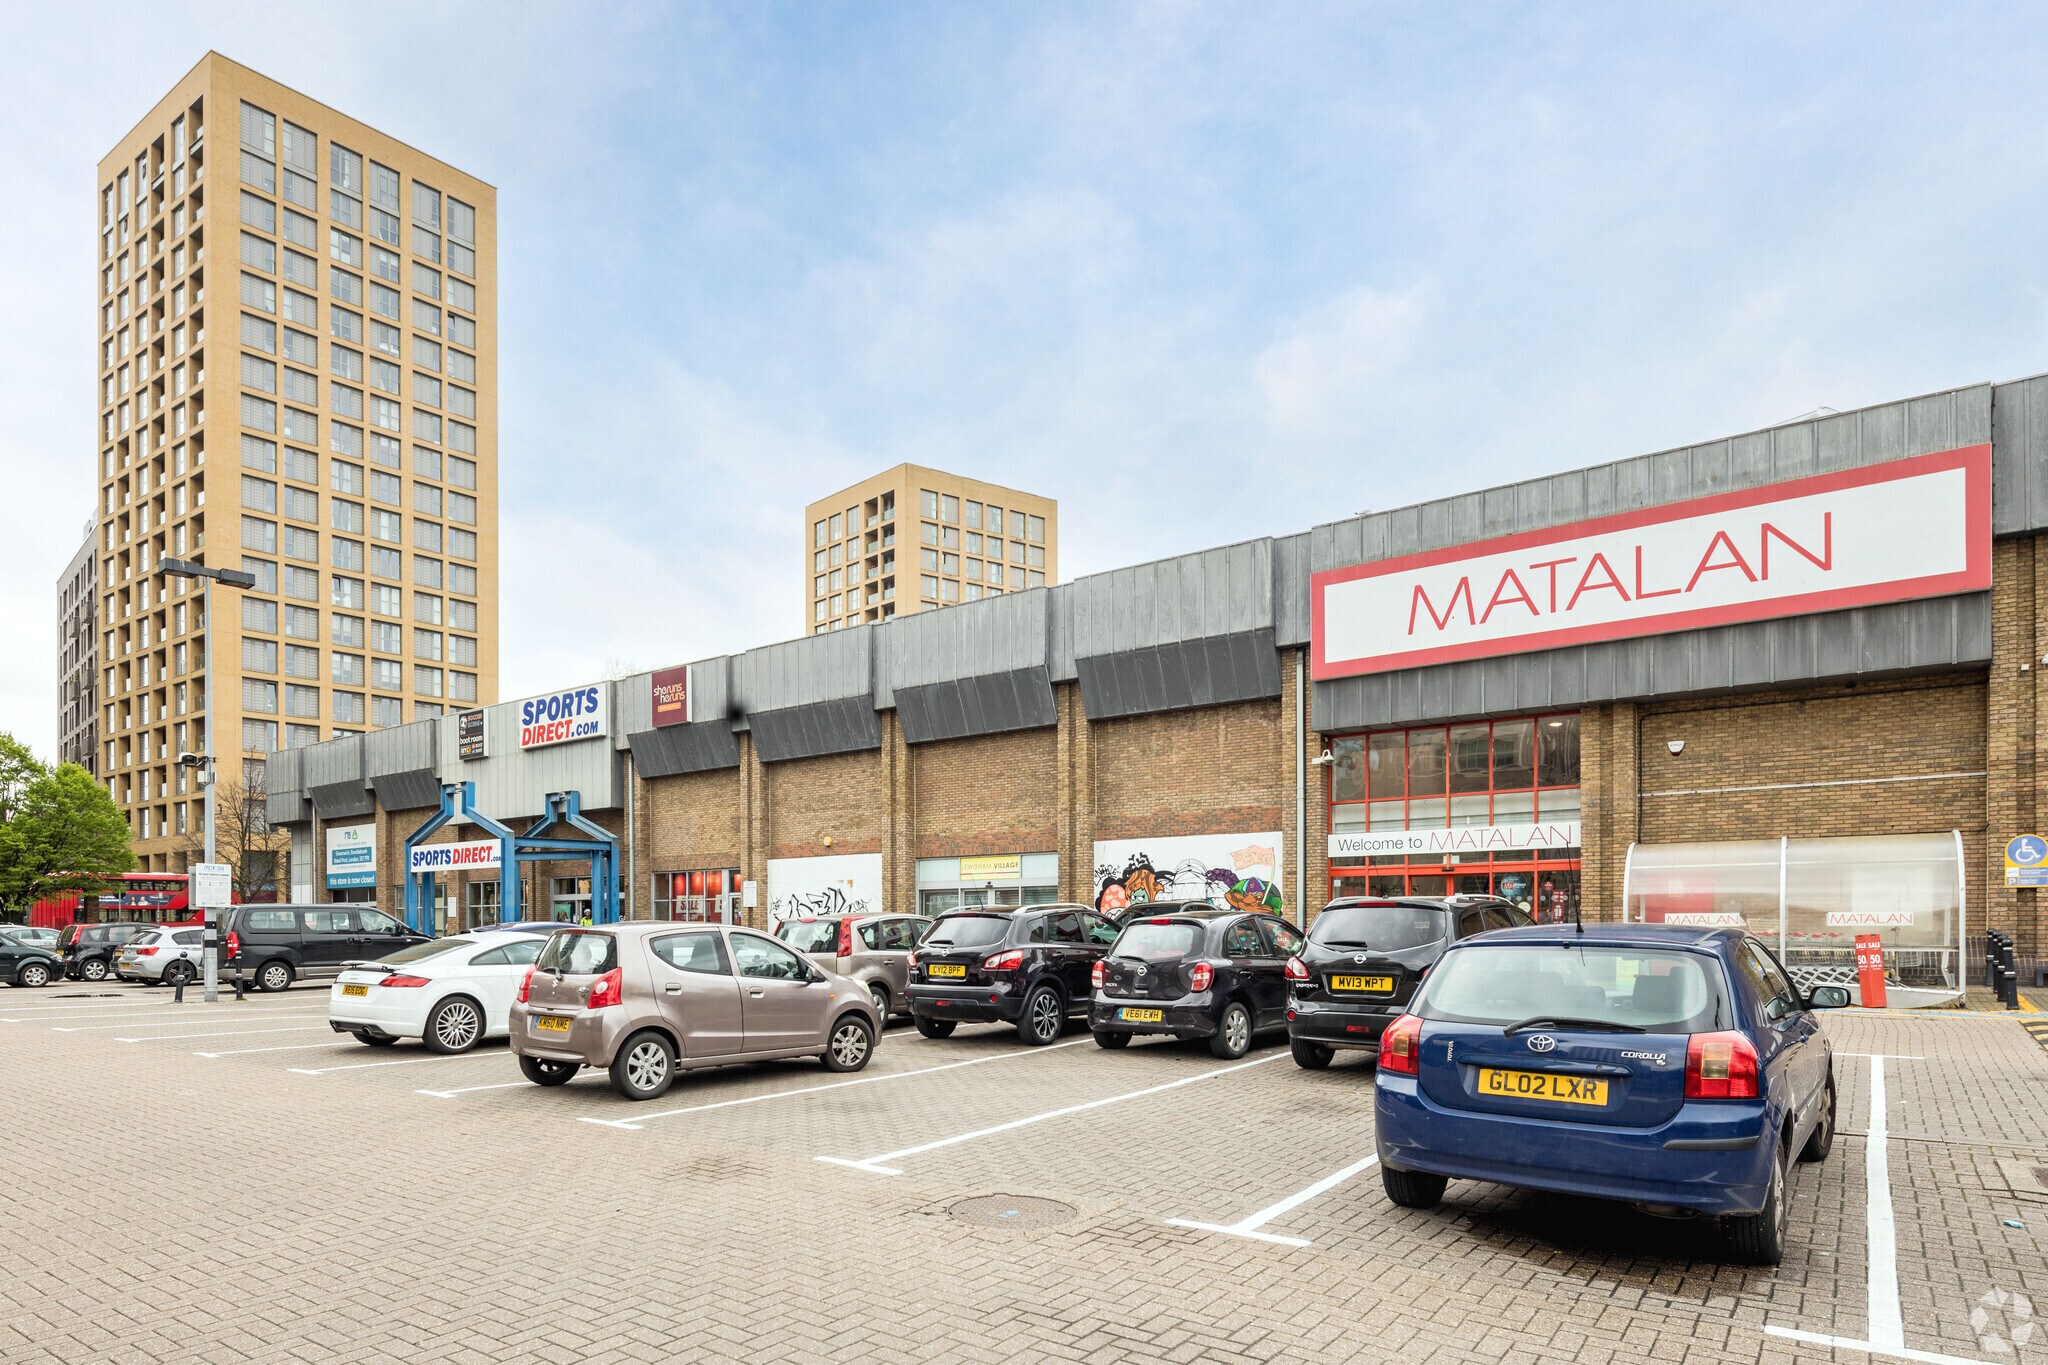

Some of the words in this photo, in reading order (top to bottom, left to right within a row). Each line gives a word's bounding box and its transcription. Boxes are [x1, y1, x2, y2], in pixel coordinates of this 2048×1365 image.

[1408, 511, 1832, 636] MATALAN
[521, 687, 599, 726] SPORTS
[1338, 839, 1404, 851] Welcome
[1408, 836, 1423, 849] to
[1429, 825, 1571, 851] MATALAN
[412, 849, 452, 867] SPORTS
[993, 861, 1019, 869] VILLAGE
[337, 877, 347, 885] store
[360, 875, 374, 883] closed
[680, 899, 700, 911] SLE
[1667, 914, 1739, 925] MATALAN
[1829, 913, 1913, 925] MATALAN
[1867, 941, 1881, 949] SALE
[932, 965, 947, 974] CY12
[948, 966, 961, 974] BPF
[1338, 976, 1362, 988] MV13
[1364, 978, 1386, 988] WPT
[1143, 1011, 1159, 1020] EWH
[1620, 1051, 1666, 1061] COROLLA
[1489, 1070, 1547, 1095] GL02
[1552, 1077, 1598, 1101] LXR
